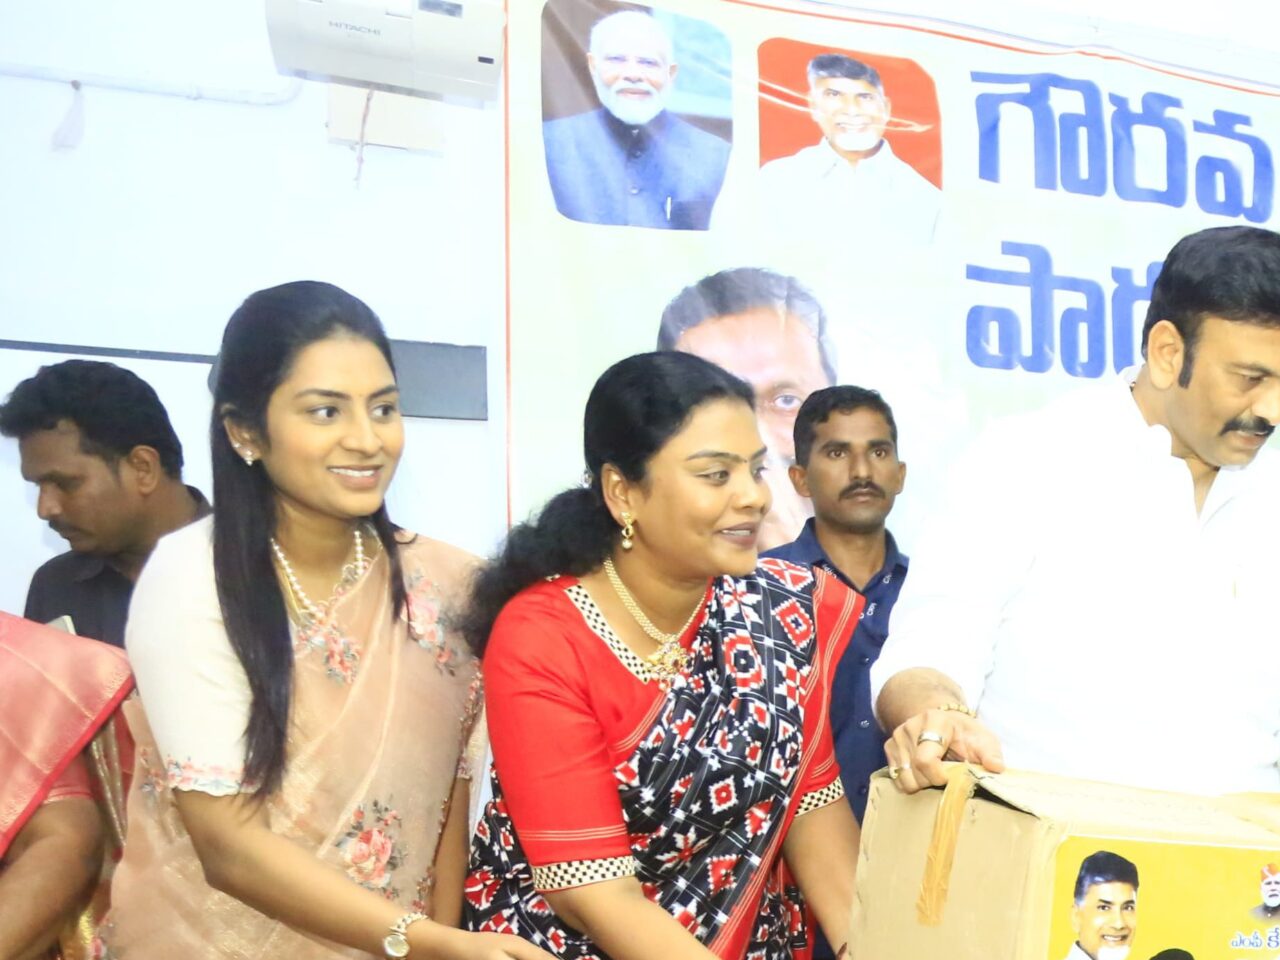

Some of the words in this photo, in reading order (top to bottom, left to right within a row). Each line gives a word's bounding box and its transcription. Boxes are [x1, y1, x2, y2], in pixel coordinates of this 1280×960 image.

[328, 19, 382, 37] HITACHI
[970, 70, 1275, 224] గౌరవ
[1231, 931, 1263, 949] ఎంపీ
